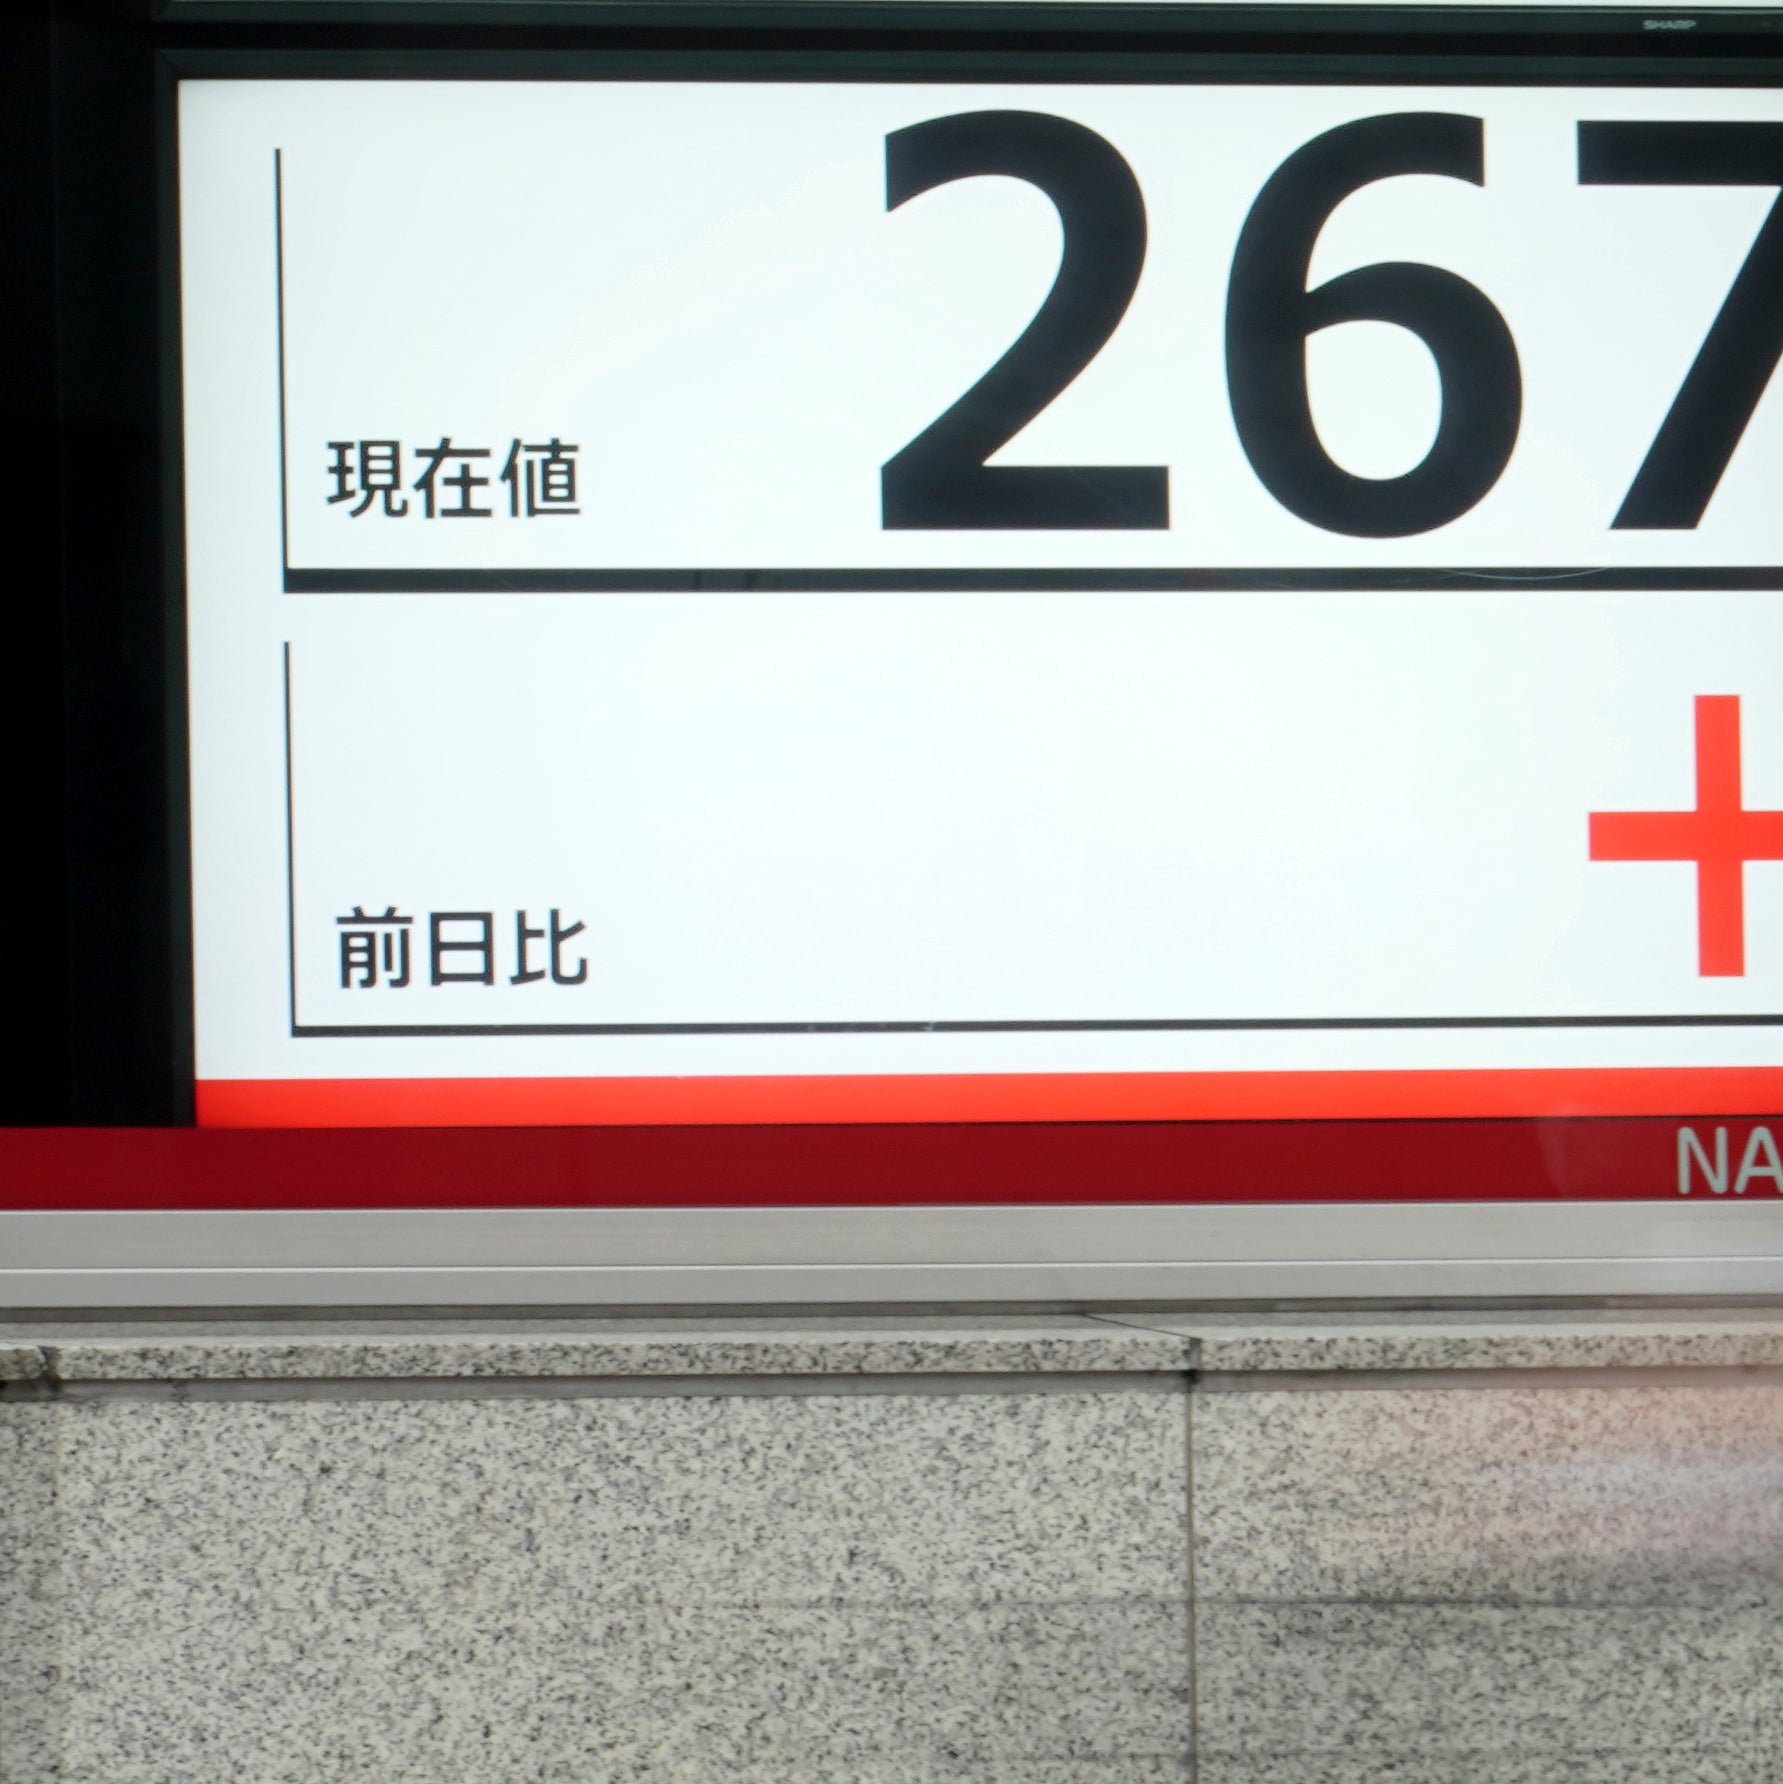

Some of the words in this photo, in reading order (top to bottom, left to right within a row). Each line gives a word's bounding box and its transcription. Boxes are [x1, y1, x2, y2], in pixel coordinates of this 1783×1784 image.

[328, 437, 579, 519] 現在値
[337, 906, 587, 989] 前日比
